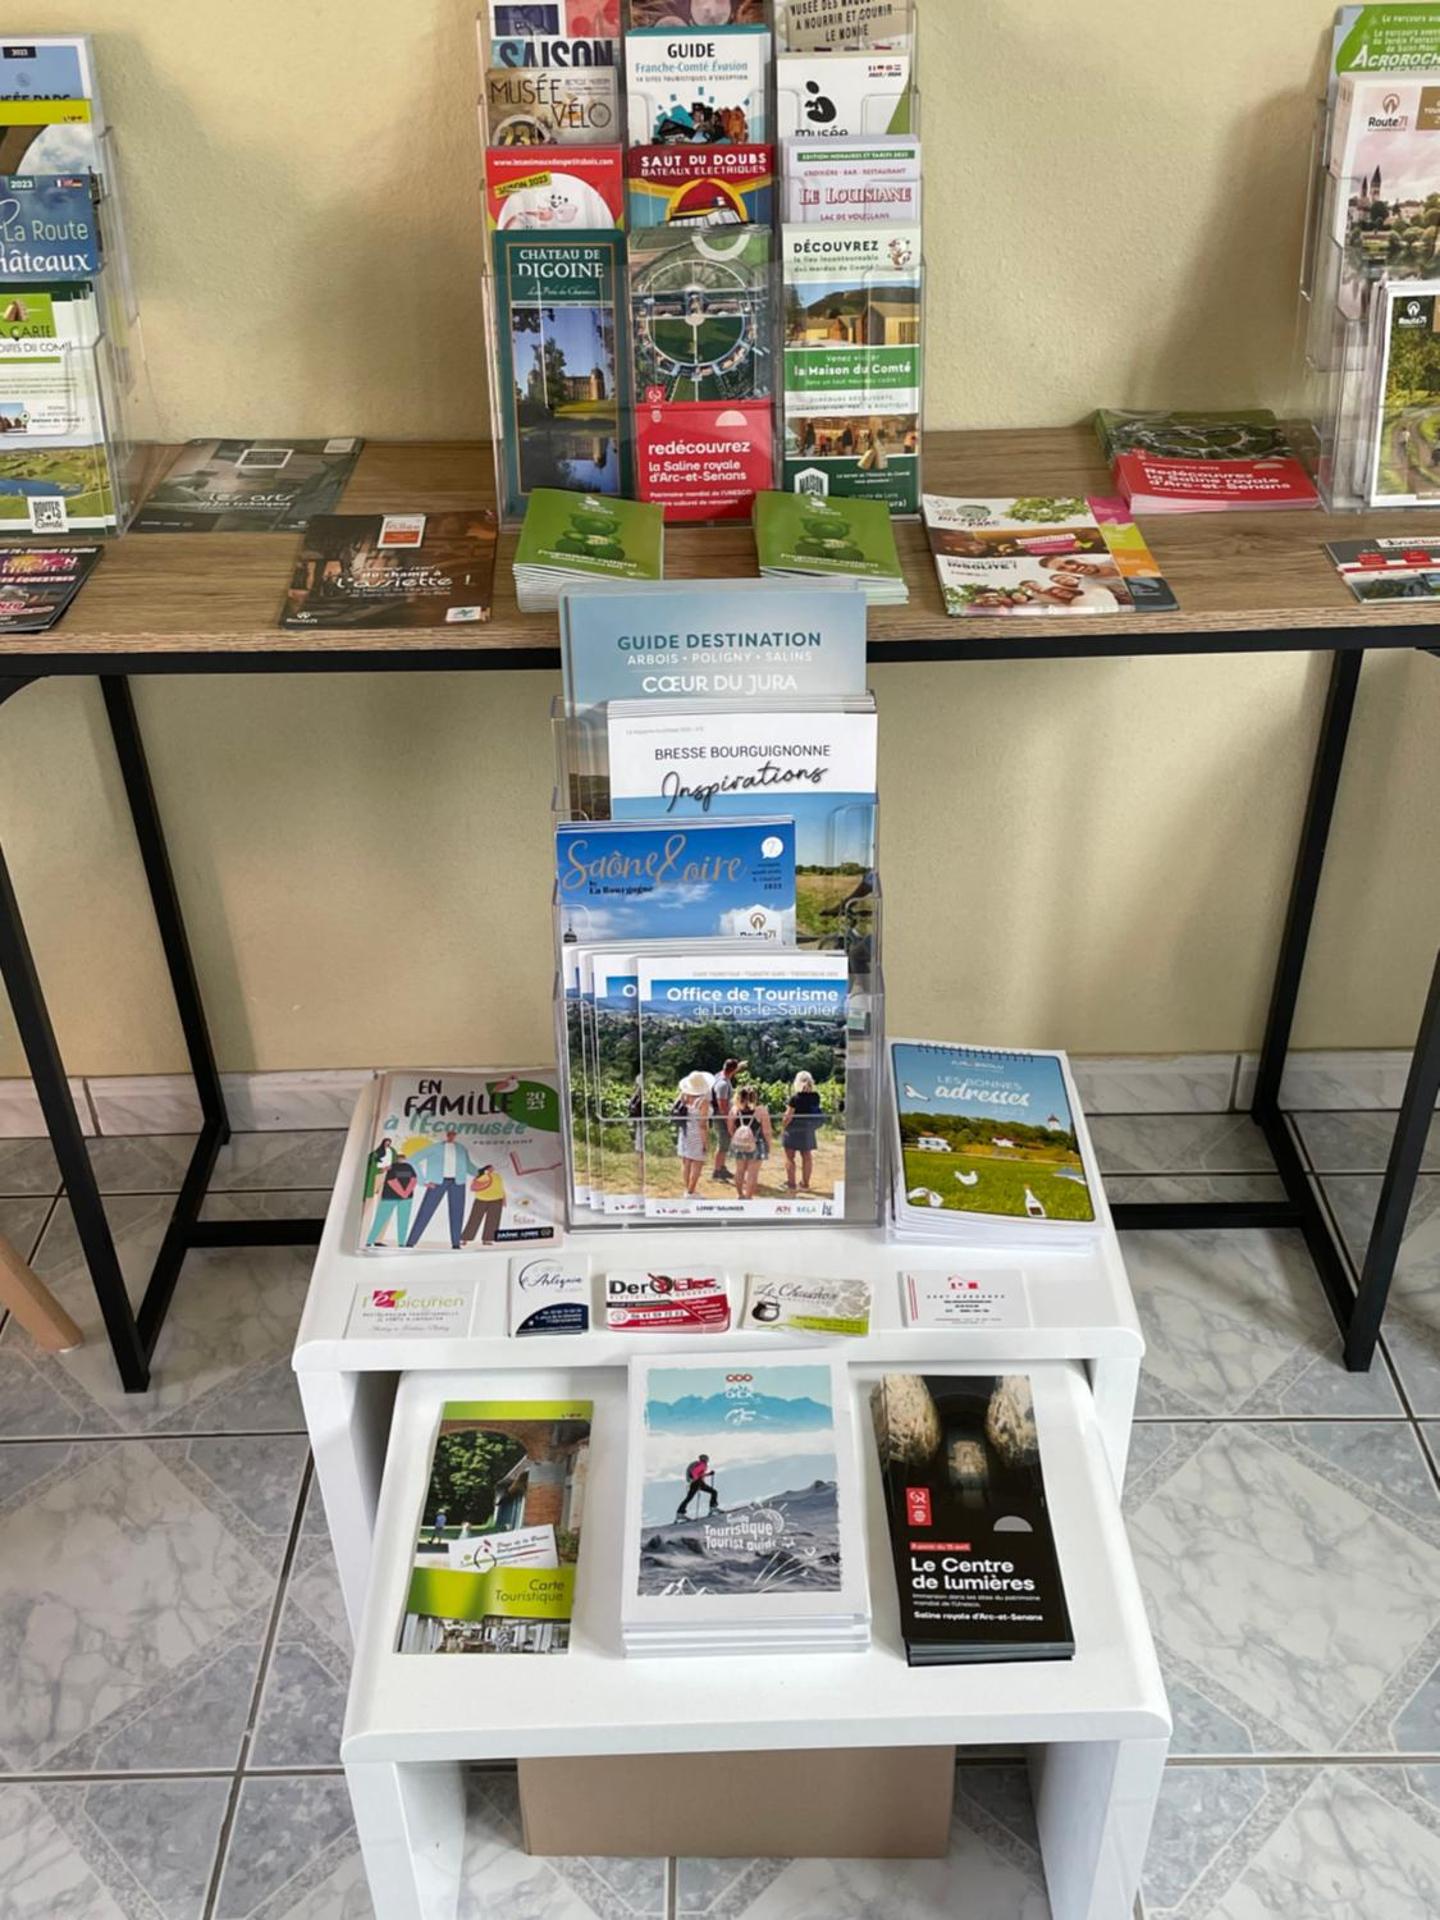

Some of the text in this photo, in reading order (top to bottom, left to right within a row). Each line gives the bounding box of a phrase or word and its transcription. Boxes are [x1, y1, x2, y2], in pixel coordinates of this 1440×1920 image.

[804, 12, 843, 29] NOURRIR
[846, 10, 856, 22] ET
[859, 3, 892, 20] COURIR
[826, 30, 836, 42] LE
[499, 40, 614, 68] SAISON
[667, 43, 716, 58] GUIDE
[635, 58, 748, 73] Franche-Comté Évasion
[490, 73, 563, 105] MUSÉE
[551, 97, 612, 129] VÉLO
[1368, 115, 1408, 128] Route71
[641, 153, 767, 168] SAUT DU DOUBS
[641, 167, 691, 176] BATEAUX
[11, 181, 33, 189] 2023
[799, 187, 912, 205] LE LOUISIANE
[820, 213, 835, 221] LAC
[4, 220, 88, 241] La Route
[793, 239, 879, 253] DÉCOUVREZ
[520, 249, 600, 260] CHÂTEAU DE
[517, 262, 605, 278] DIGOINE
[794, 361, 911, 376] la Maison du Comté
[648, 440, 751, 455] redécouvrez
[649, 459, 741, 472] la Saline royale
[1144, 467, 1254, 479] Redécouvrez
[649, 471, 747, 483] d'Arc-et-Senans
[1167, 475, 1221, 484] Saline
[1225, 478, 1280, 486] royale
[617, 632, 822, 651] GUIDE DESTINATION
[627, 650, 812, 665] ARBOIS POLIGNY SALINS
[642, 674, 798, 695] CŒUR DU JURA
[655, 745, 831, 760] BRESSE BOURGUIGNONNE
[661, 760, 829, 813] Inspirations
[667, 986, 838, 1001] Office de Tourisme
[693, 1001, 838, 1016] de Lons-le-Saunier
[418, 1079, 443, 1095] EN
[936, 1075, 1023, 1092] LES BONNES
[933, 1082, 1031, 1108] adresses
[404, 1091, 513, 1117] FAMILLE
[384, 1115, 398, 1131] à
[704, 1521, 773, 1541] Touristique
[705, 1535, 744, 1551] Tourist
[911, 1557, 1014, 1573] Le Centre
[529, 1579, 565, 1591] Carte
[912, 1574, 1035, 1591] de lumières
[495, 1590, 564, 1605] Touristique
[914, 1611, 941, 1619] Saline
[943, 1612, 970, 1622] royale
